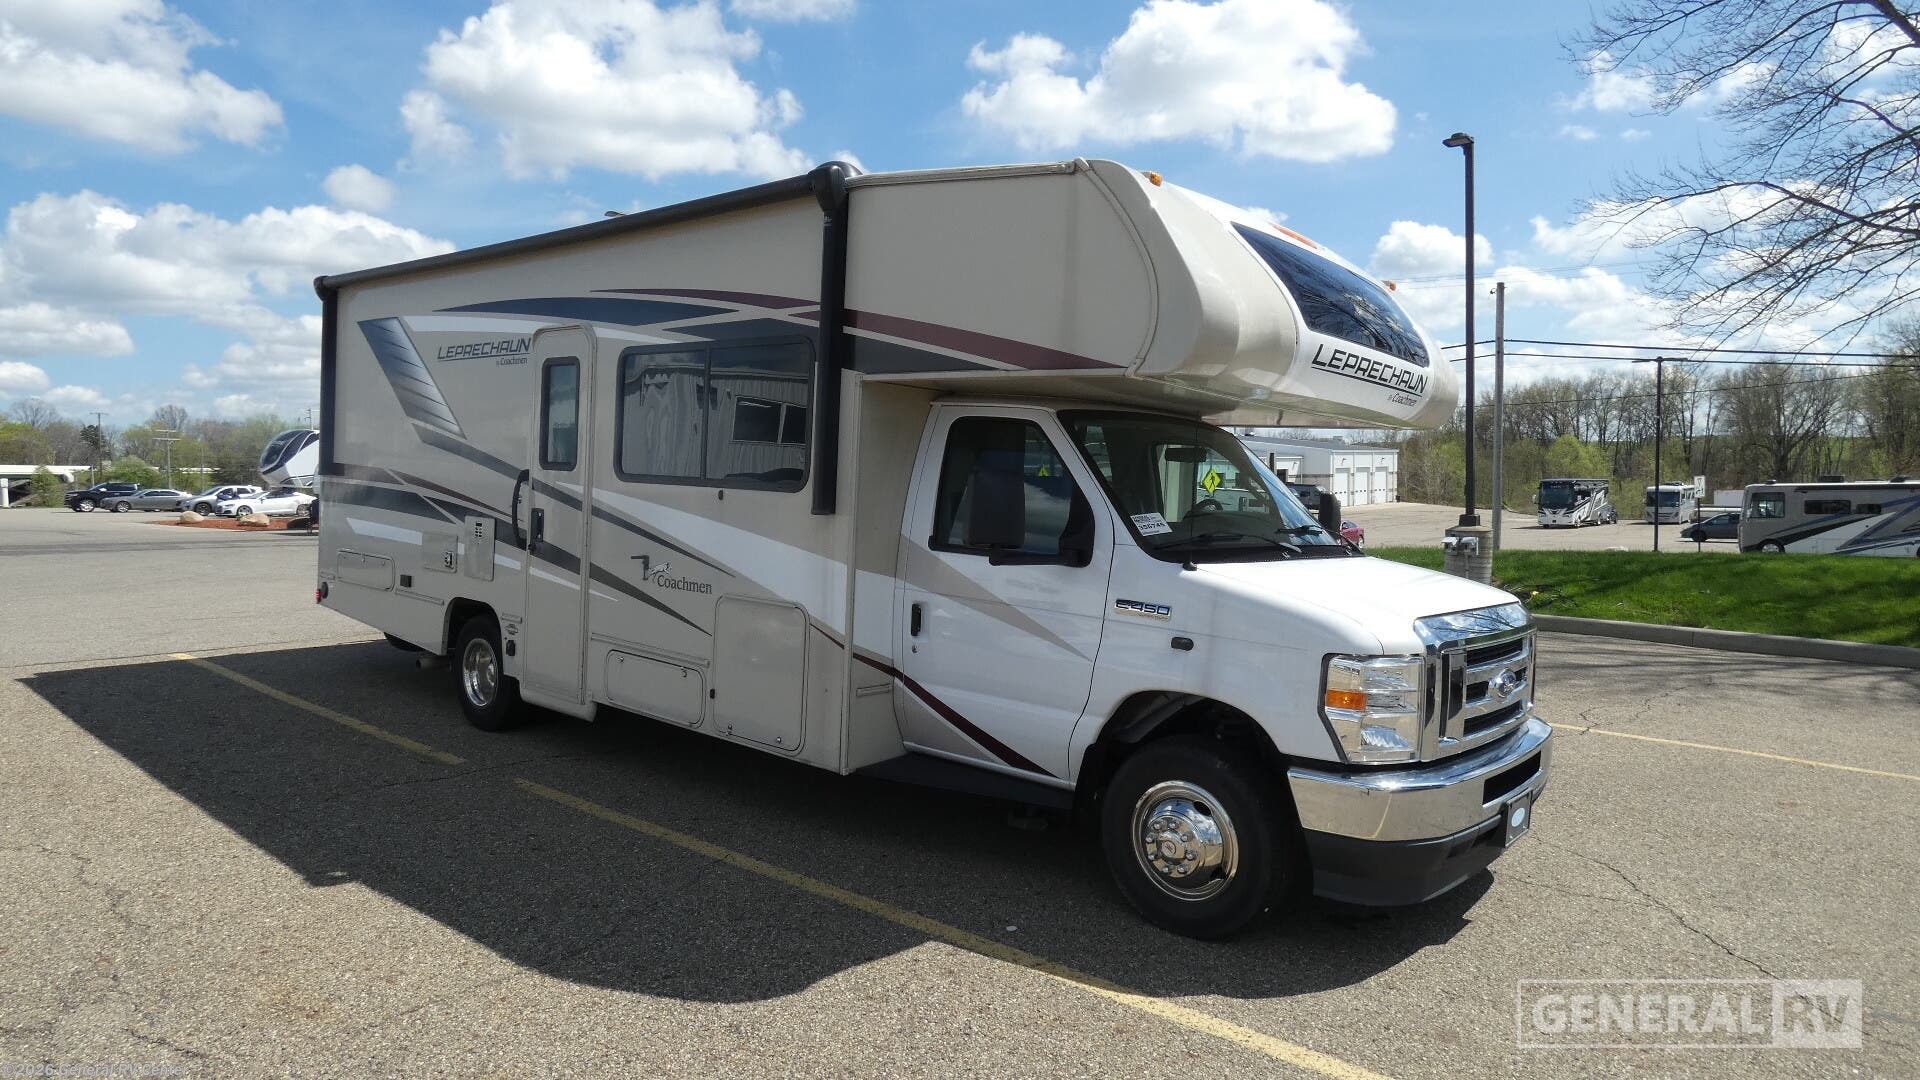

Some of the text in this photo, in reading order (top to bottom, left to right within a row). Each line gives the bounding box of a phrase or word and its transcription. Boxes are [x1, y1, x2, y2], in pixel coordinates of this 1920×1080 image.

[437, 337, 532, 360] LEPRECHAUN
[1311, 343, 1429, 394] LEPRECHAUN
[657, 574, 713, 594] Coachmen
[1115, 599, 1171, 616] E450
